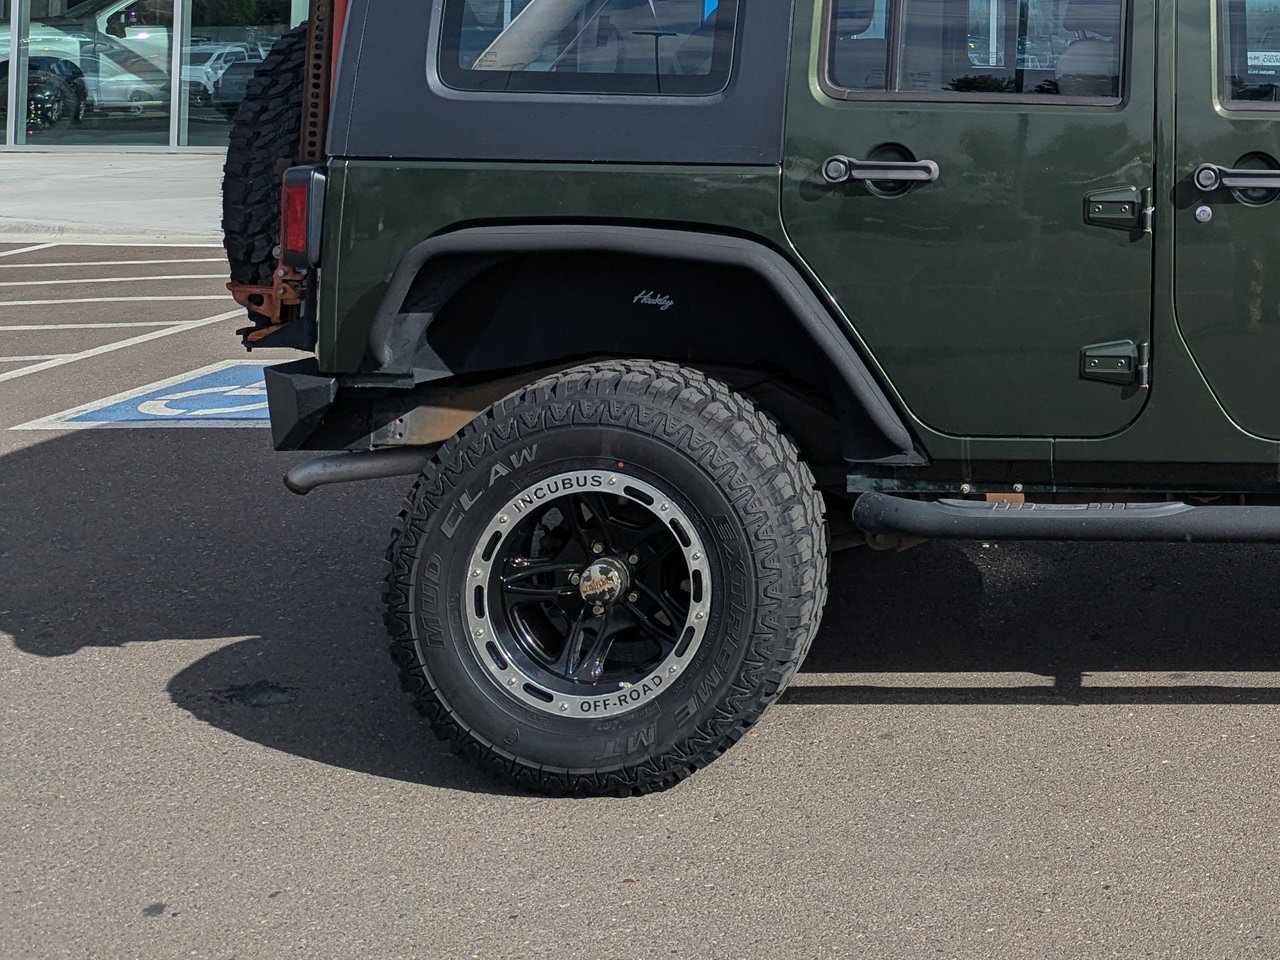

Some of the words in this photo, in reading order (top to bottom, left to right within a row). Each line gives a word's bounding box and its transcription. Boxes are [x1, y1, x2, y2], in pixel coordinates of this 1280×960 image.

[420, 552, 447, 649] MUD
[440, 443, 538, 539] CLAW
[512, 474, 604, 514] INCUBUS
[672, 514, 749, 729] EXTREME
[579, 673, 664, 714] OFF-ROAD
